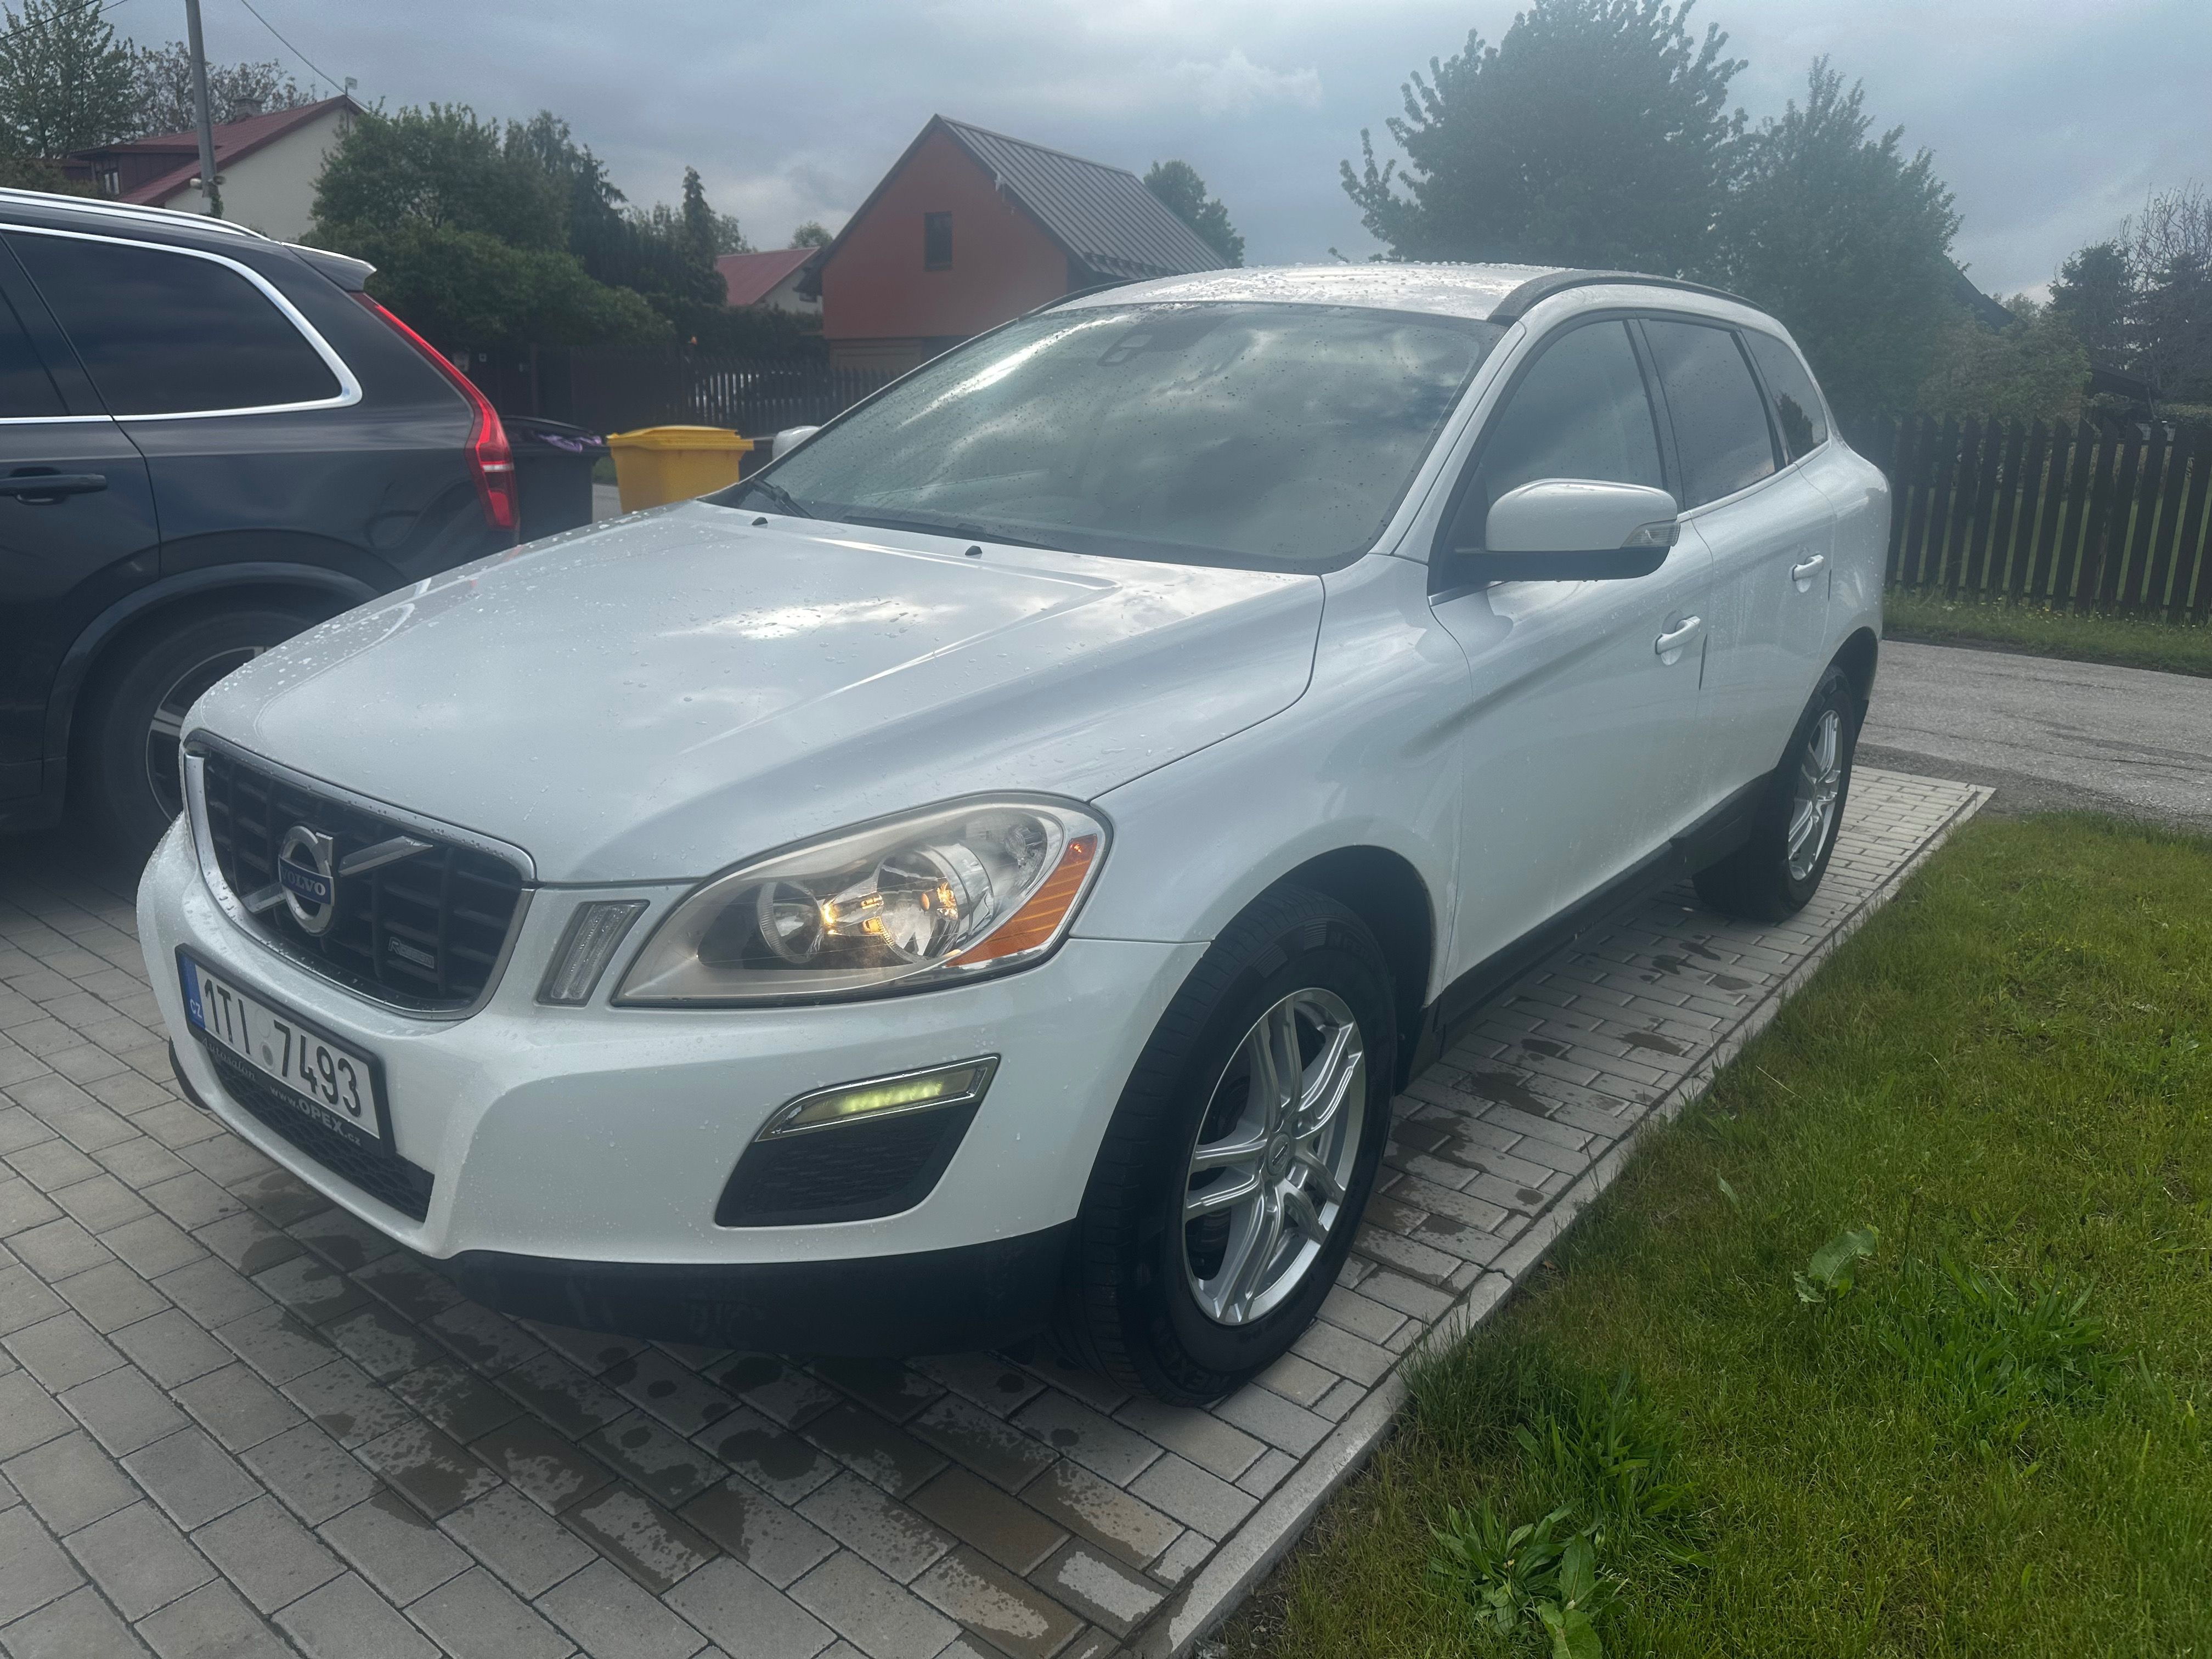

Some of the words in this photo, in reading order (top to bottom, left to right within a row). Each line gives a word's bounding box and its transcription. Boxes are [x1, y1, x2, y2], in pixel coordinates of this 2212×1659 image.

[280, 865, 326, 896] VOLVO
[190, 998, 202, 1019] CZ
[201, 1037, 256, 1081] Autosalon
[273, 1019, 362, 1117] 7493
[269, 1085, 362, 1147] www.OPEX.cz
